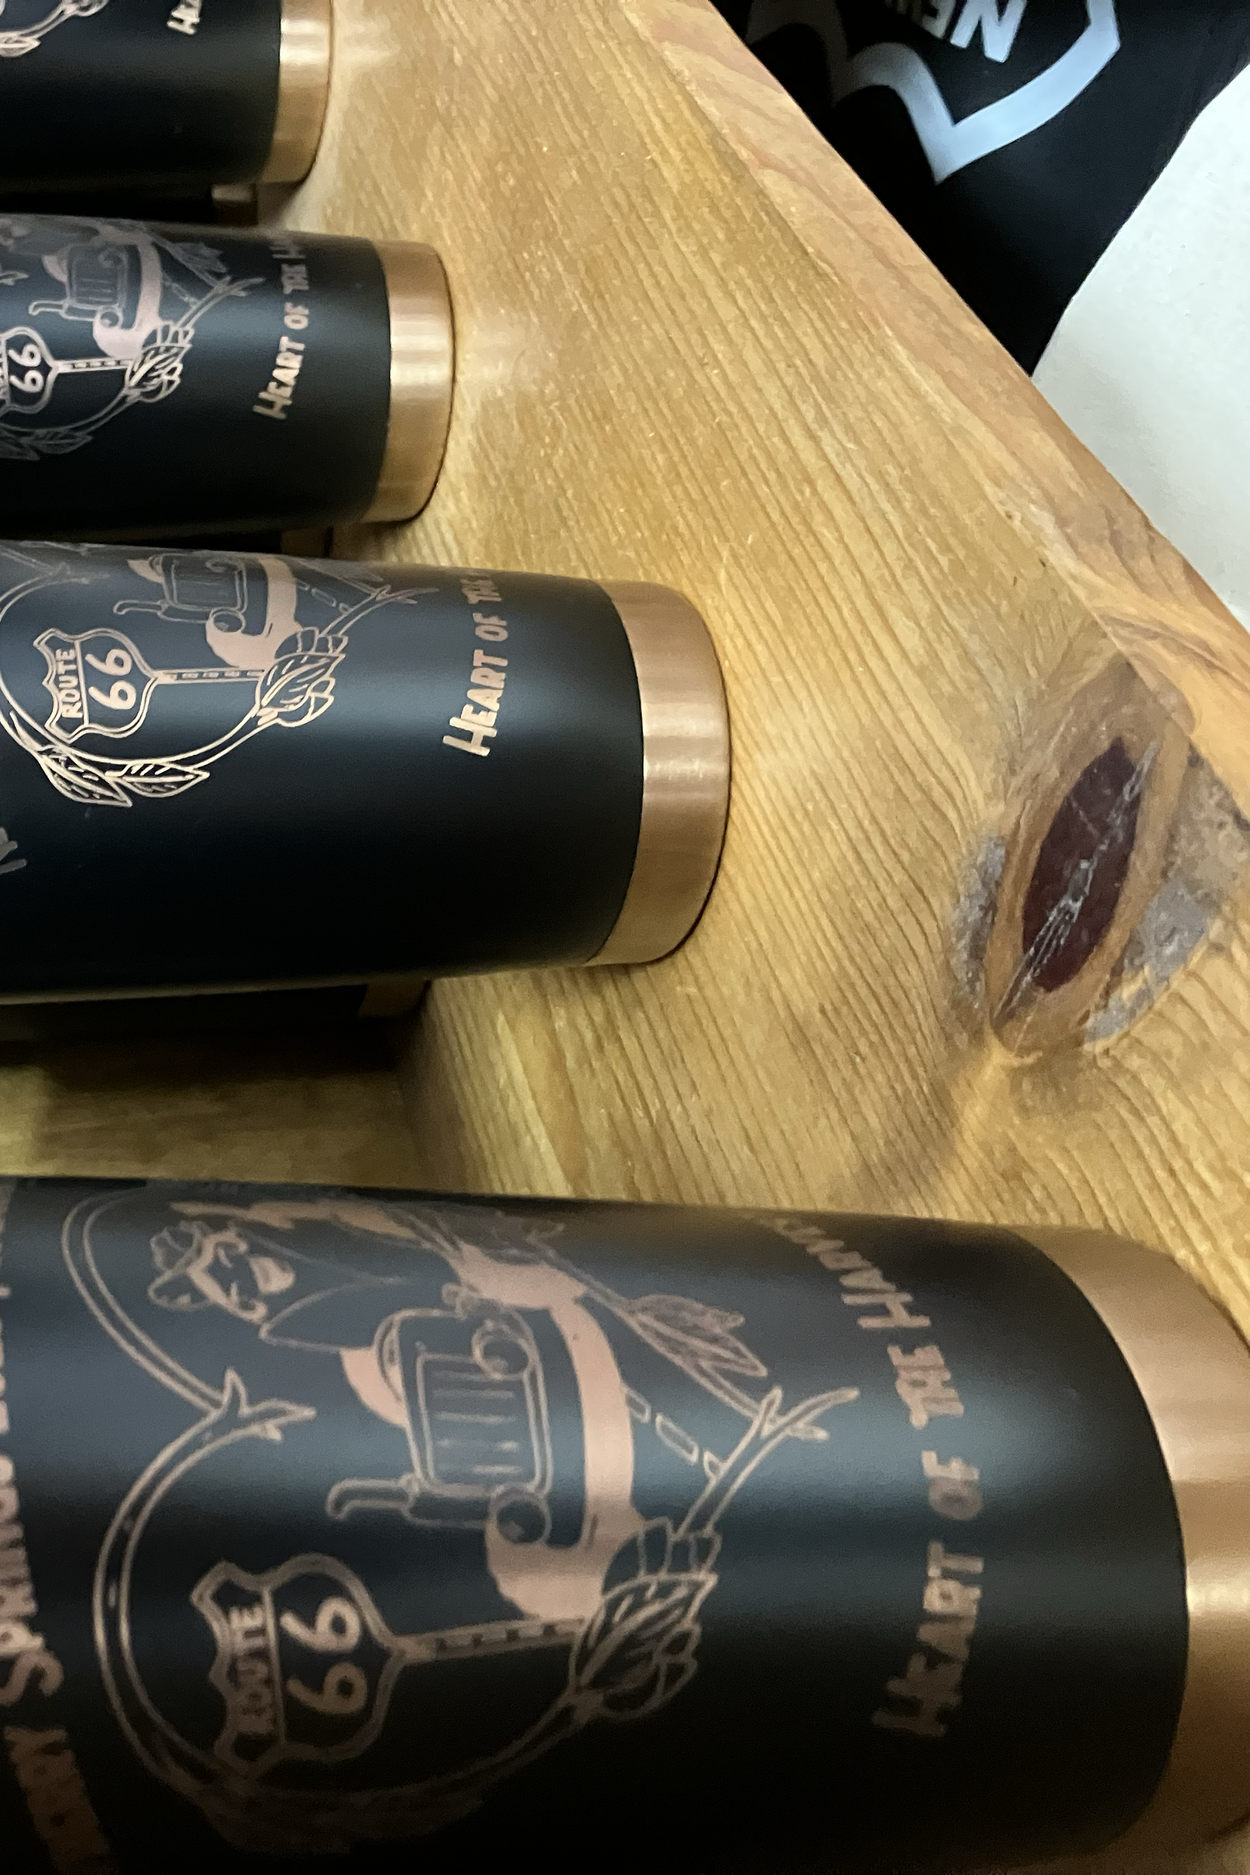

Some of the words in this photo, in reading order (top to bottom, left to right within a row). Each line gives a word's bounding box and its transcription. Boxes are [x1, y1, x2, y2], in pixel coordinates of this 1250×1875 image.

[8, 343, 45, 393] 66
[252, 335, 306, 421] HEART
[283, 301, 310, 330] OF
[472, 611, 509, 642] OF
[56, 646, 84, 721] ROUTE
[86, 647, 136, 711] 66
[442, 648, 508, 757] HEART
[886, 1342, 965, 1428] THE
[920, 1449, 984, 1521] OF
[278, 1595, 368, 1716] 66
[871, 1540, 985, 1739] HEART
